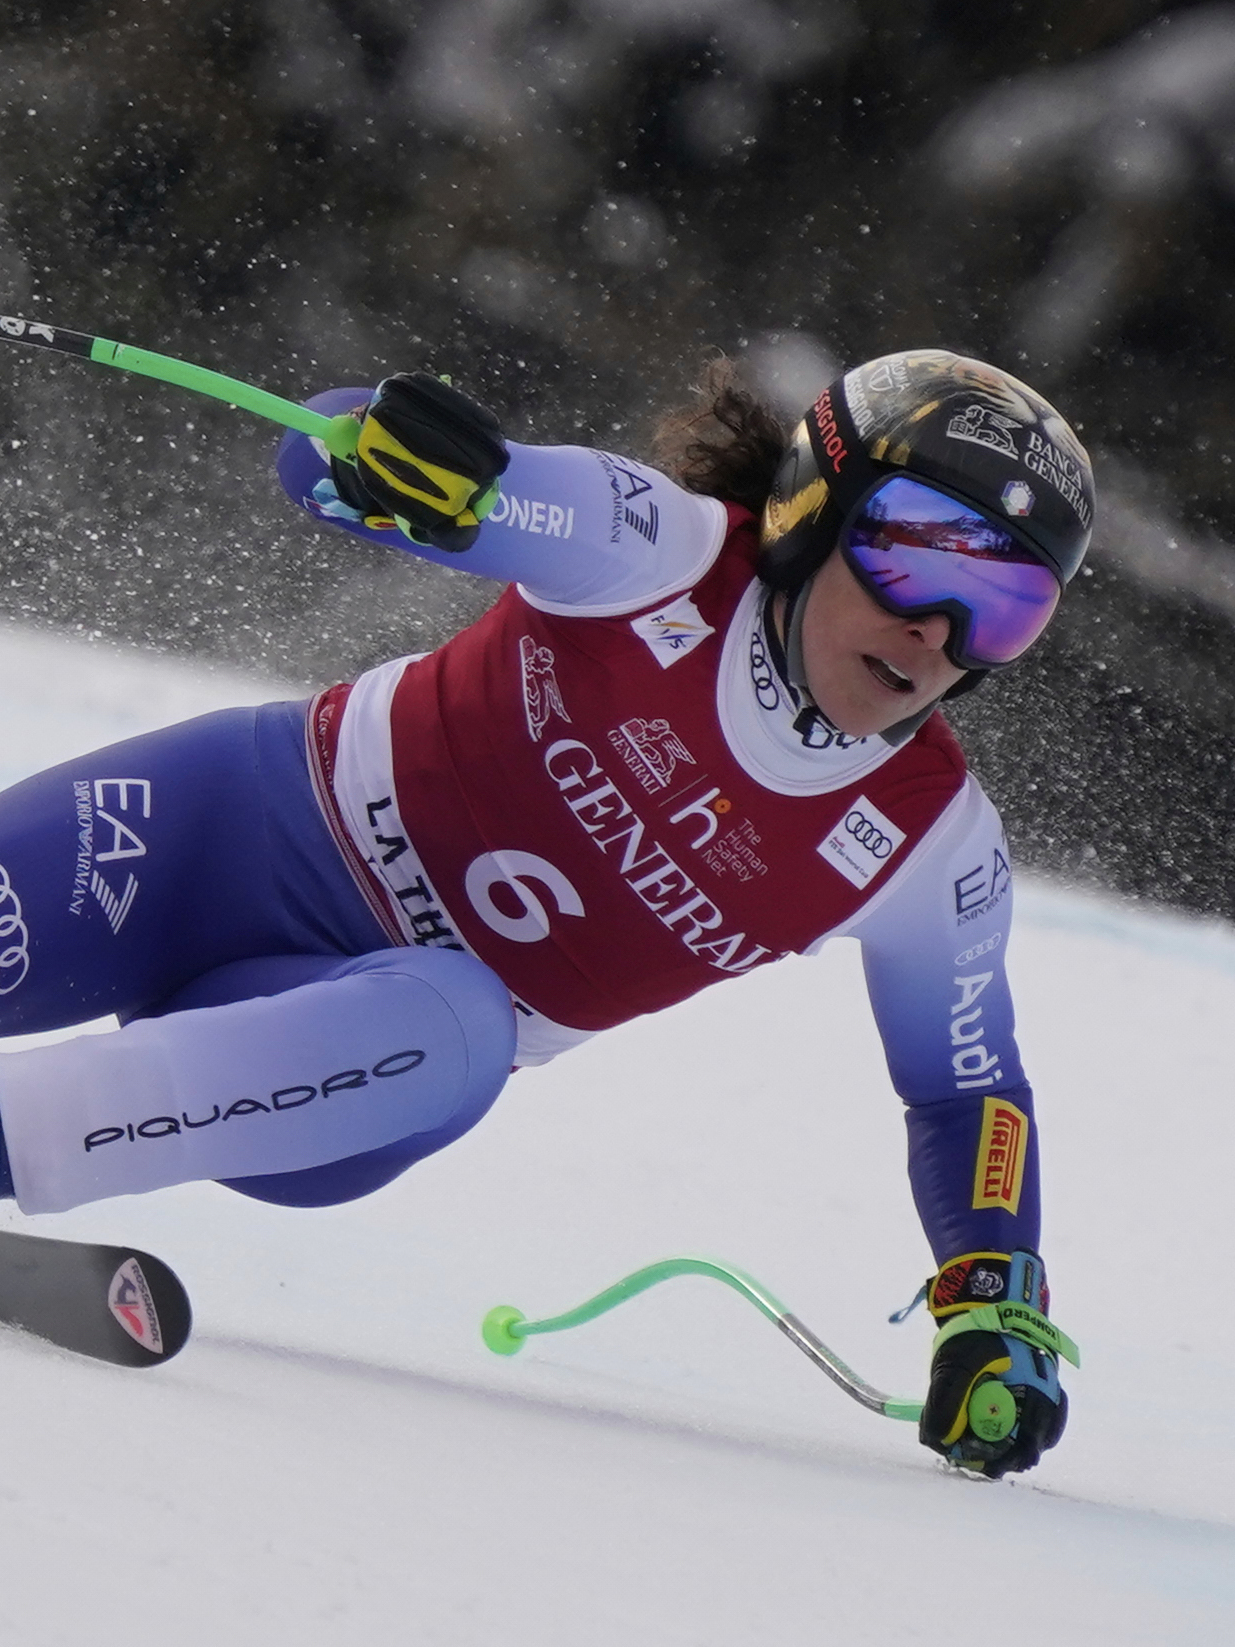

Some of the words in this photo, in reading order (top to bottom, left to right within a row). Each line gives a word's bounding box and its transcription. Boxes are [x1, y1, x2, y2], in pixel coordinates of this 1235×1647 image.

[814, 389, 848, 473] SSIGNOL
[1028, 431, 1083, 489] BANCA
[487, 491, 575, 539] ONERI
[1024, 450, 1092, 529] GENERALI
[650, 615, 686, 649] FIS
[607, 729, 661, 796] GENERALI
[73, 780, 94, 829] EMPORIO
[366, 796, 410, 866] LA
[739, 818, 762, 846] The
[69, 846, 93, 916] ARMANI
[90, 778, 152, 936] EA7
[544, 738, 777, 974] GENERAL
[702, 848, 728, 878] Net
[711, 839, 754, 883] Safety
[724, 830, 769, 876] Human
[954, 845, 1010, 915] EA
[465, 849, 585, 943] 6
[950, 971, 1003, 1090] Audi
[84, 1050, 426, 1152] PIQUADRO
[983, 1108, 1021, 1201] PIRELLI
[131, 1264, 160, 1345] ROSSIGNOL
